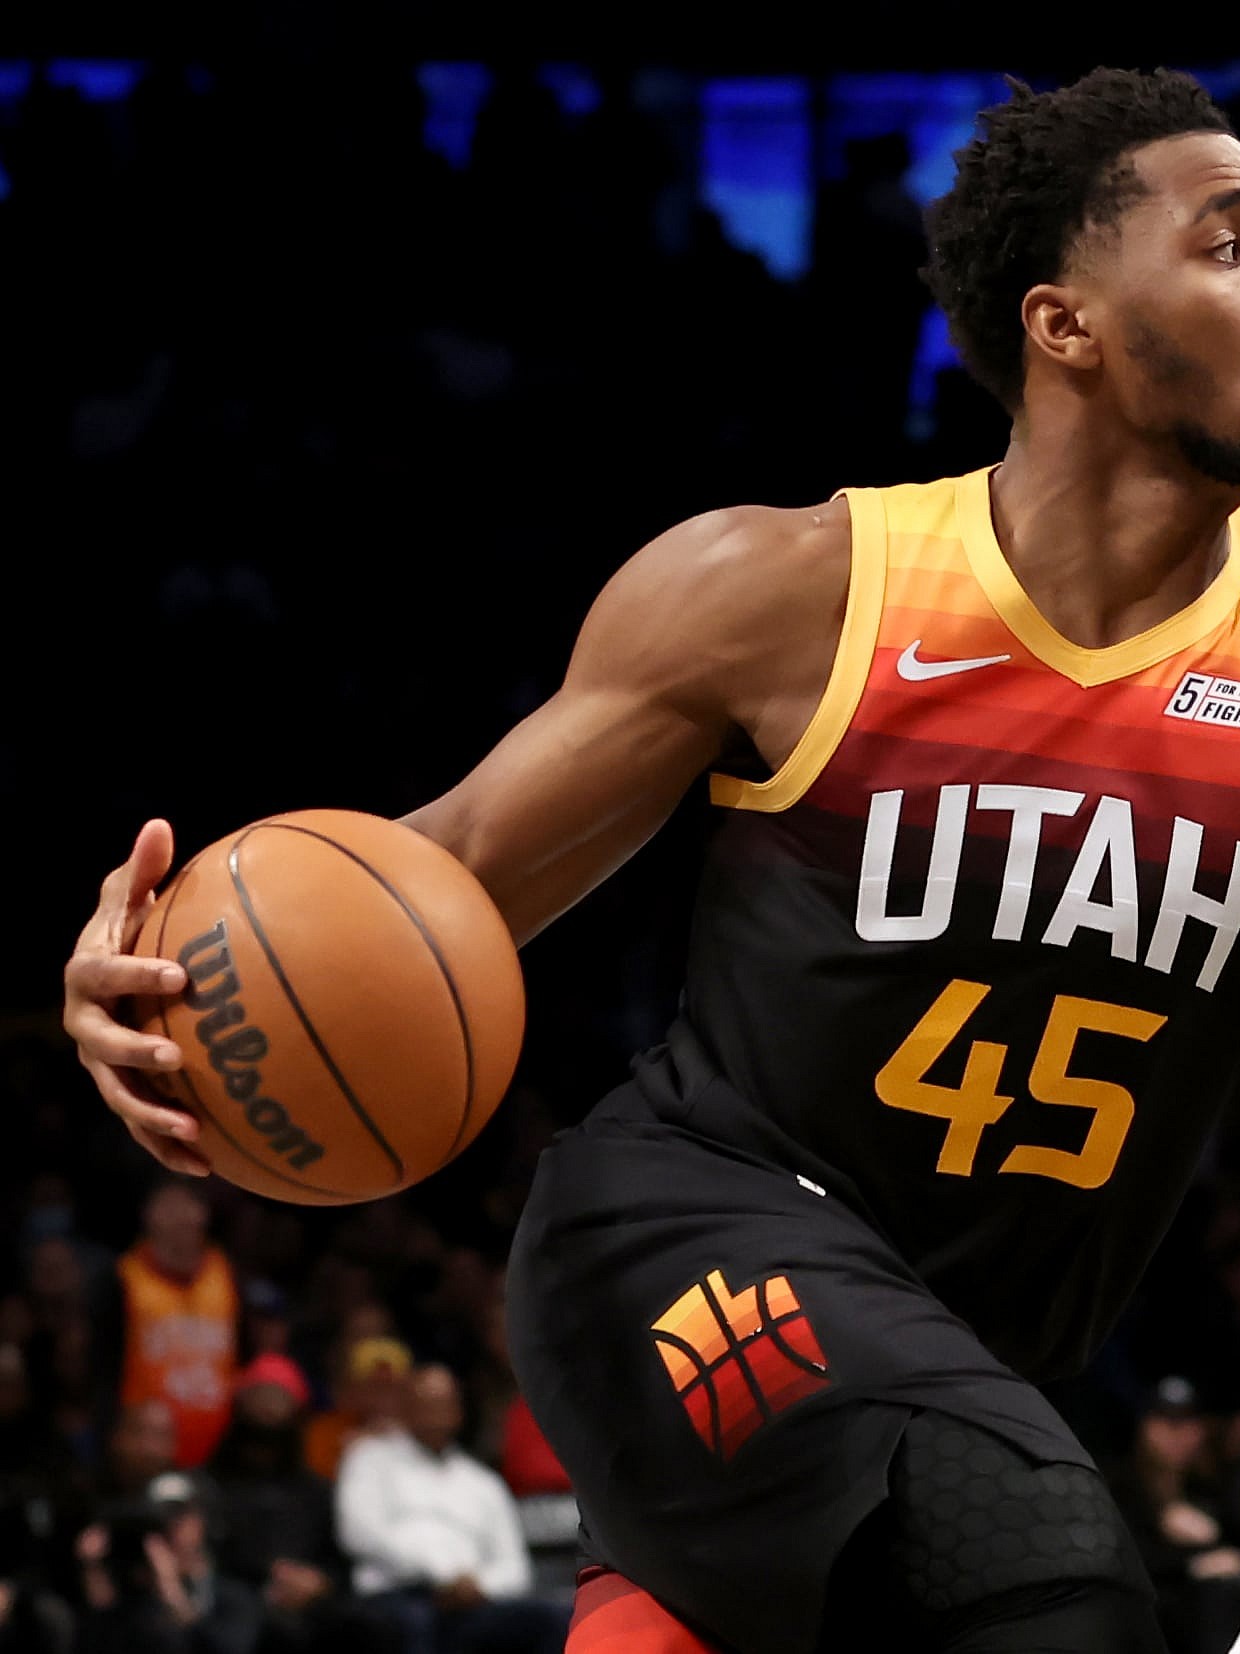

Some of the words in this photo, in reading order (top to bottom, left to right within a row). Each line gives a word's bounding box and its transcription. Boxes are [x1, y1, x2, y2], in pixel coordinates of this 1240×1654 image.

[1173, 677, 1205, 713] 5
[1215, 683, 1237, 696] FOR
[176, 918, 327, 1172] Wilson
[874, 978, 1169, 1190] 45
